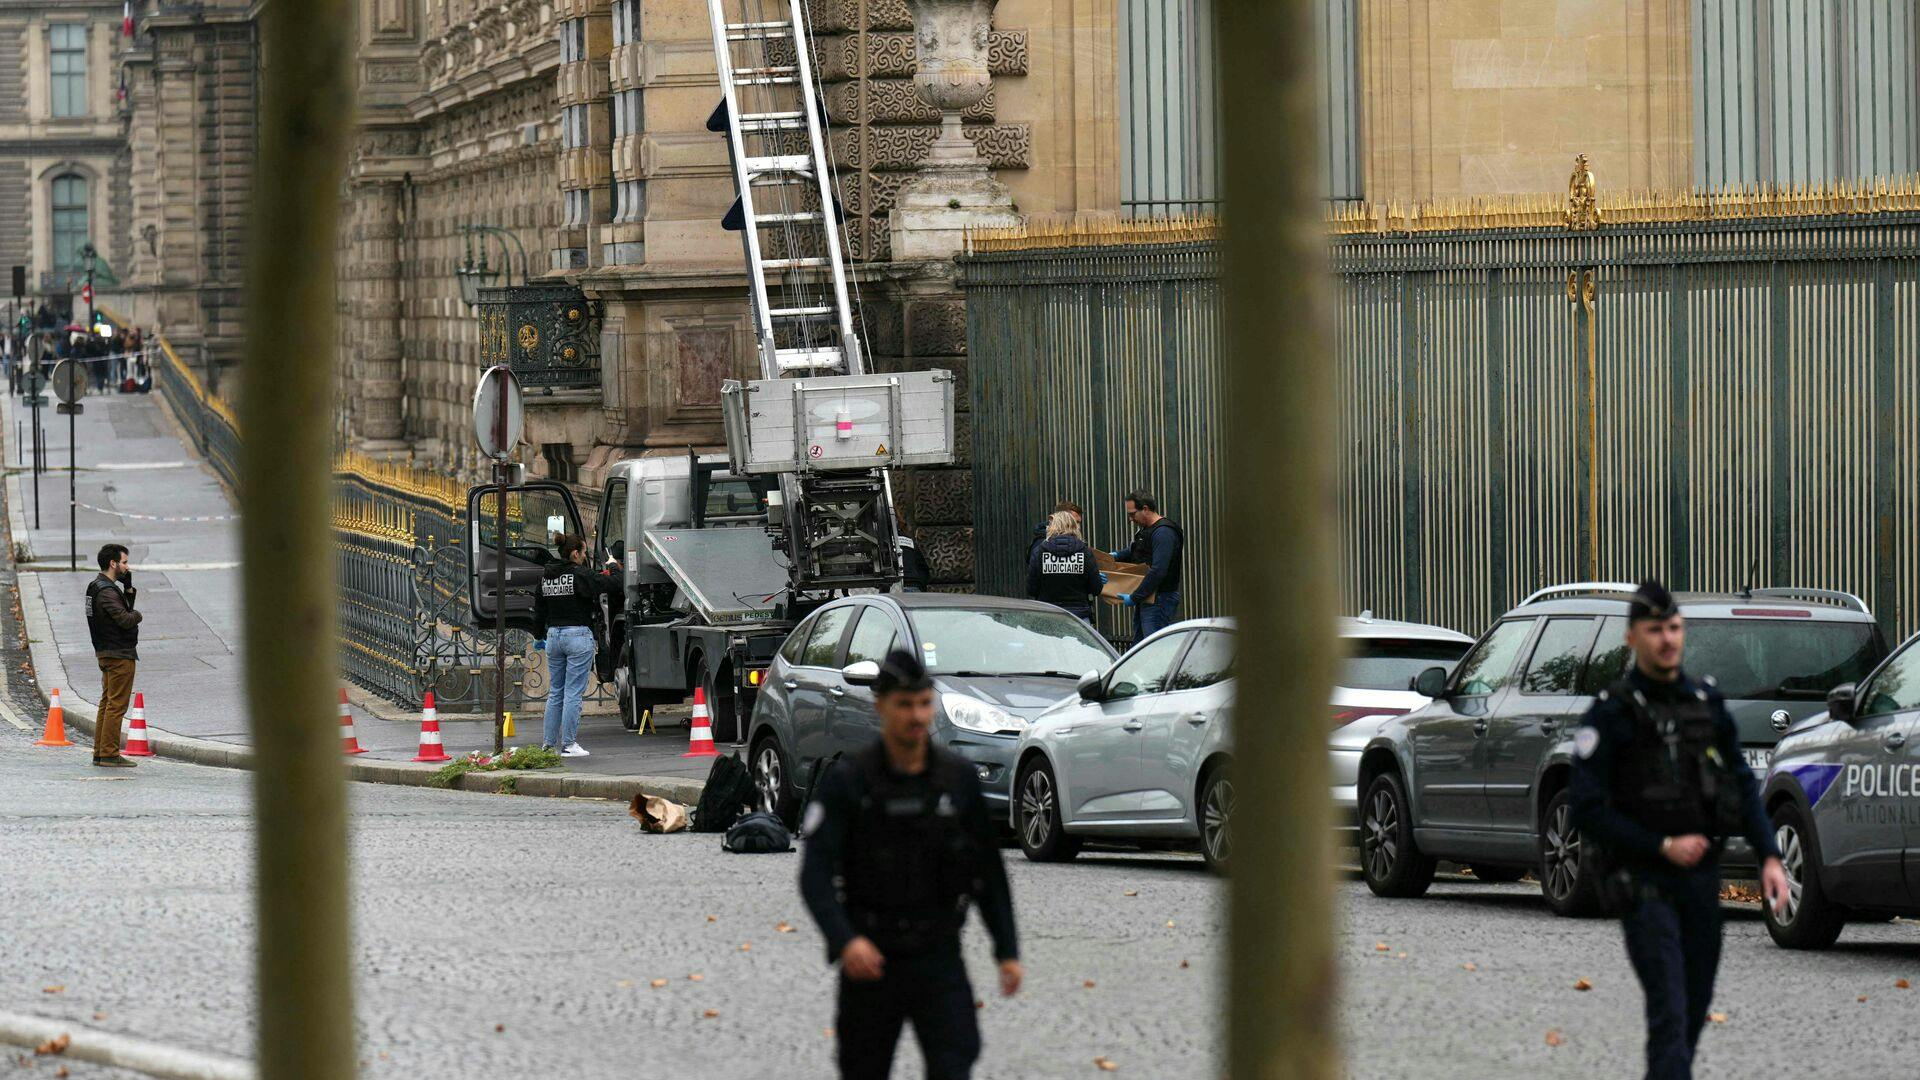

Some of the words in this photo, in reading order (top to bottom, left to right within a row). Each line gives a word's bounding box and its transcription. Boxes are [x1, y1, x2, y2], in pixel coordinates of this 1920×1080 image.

[1043, 553, 1083, 563] POLICE
[1043, 563, 1083, 573] JUDICIAIRE
[542, 575, 573, 586] POLICE
[1846, 764, 1920, 797] POLICE
[1846, 804, 1920, 824] NATIONAL
